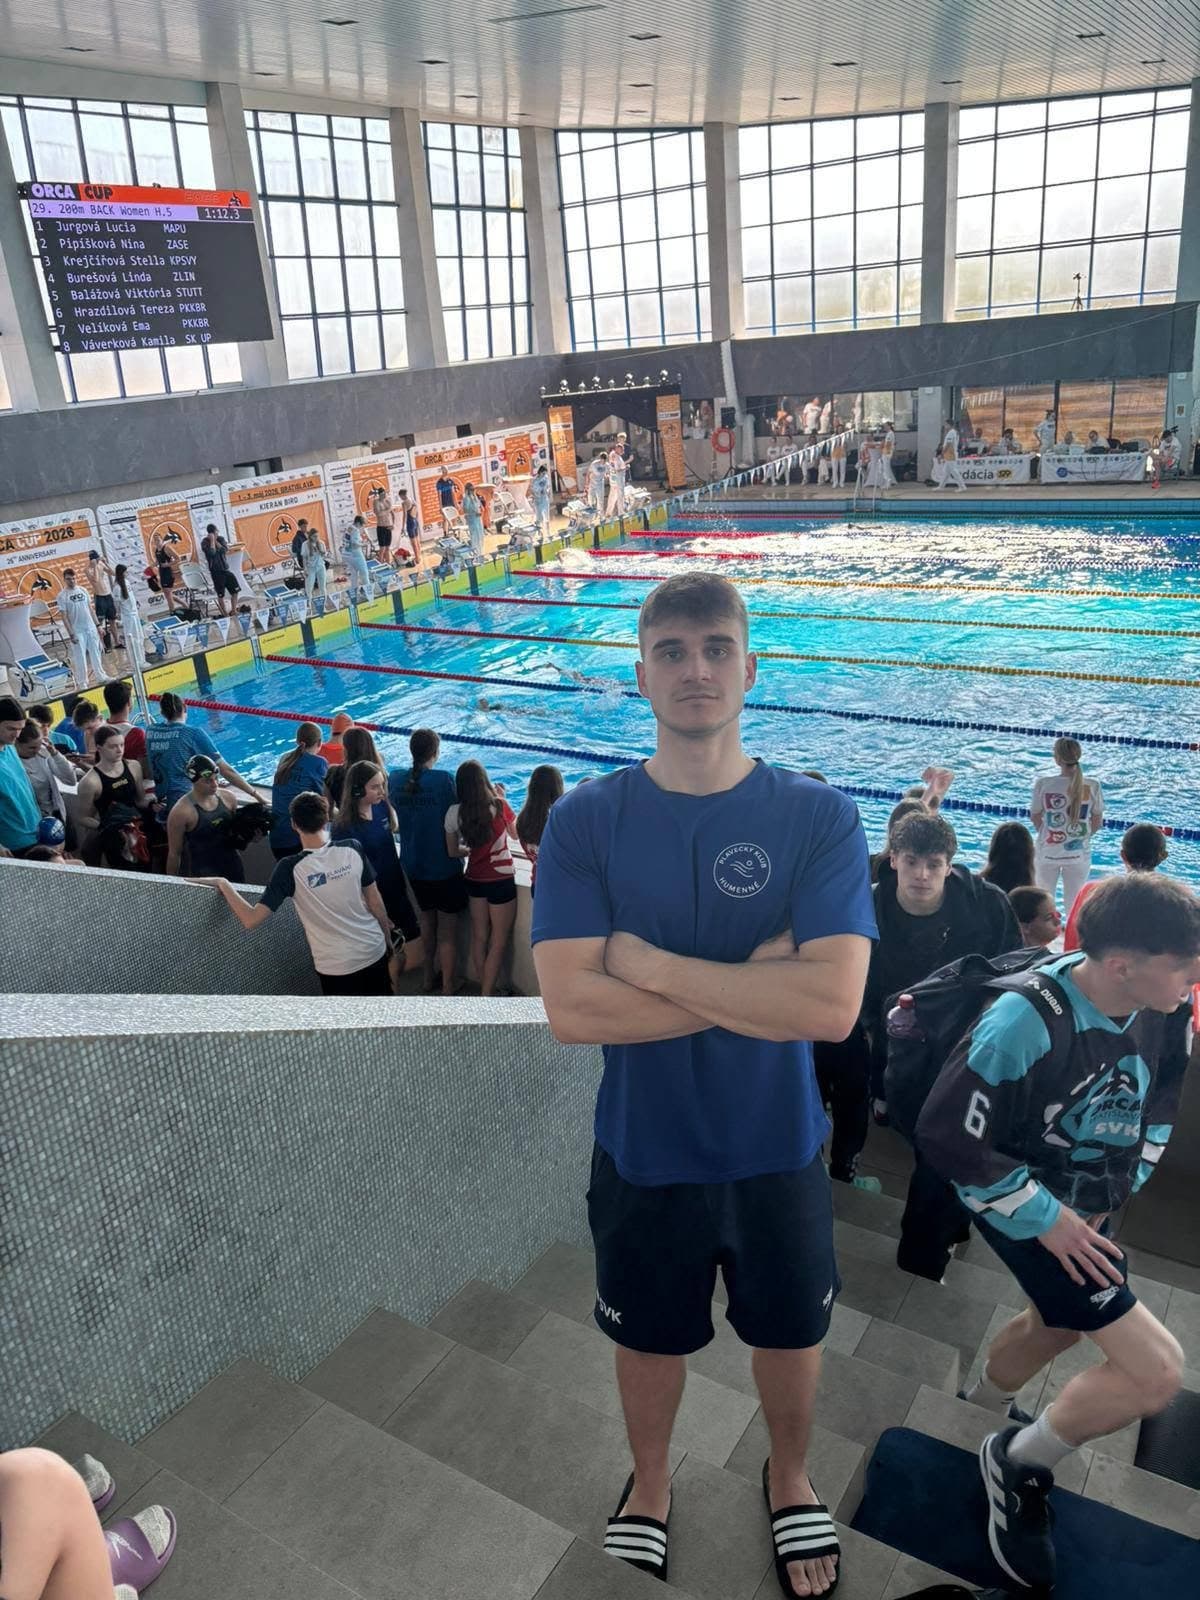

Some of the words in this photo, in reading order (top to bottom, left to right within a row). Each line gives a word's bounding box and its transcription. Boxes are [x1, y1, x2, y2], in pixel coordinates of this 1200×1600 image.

[31, 183, 76, 199] ORCA
[84, 185, 113, 200] CUP
[32, 203, 51, 214] 29.
[59, 203, 85, 214] 200m
[90, 204, 116, 215] BACK
[120, 205, 150, 217] Women
[154, 207, 173, 218] H.5
[204, 208, 241, 220] 1:12.3
[36, 221, 44, 231] 1
[55, 221, 101, 235] Jurgová
[106, 221, 136, 233] Lucia
[163, 223, 187, 234] MAPU
[40, 239, 48, 249] 2
[121, 239, 145, 249] Nina
[166, 239, 190, 250] ZASE
[43, 256, 51, 267] 3
[130, 255, 166, 266] Stella
[48, 273, 55, 283] 4
[67, 272, 118, 284] Burešová
[122, 271, 152, 282] Linda
[173, 271, 196, 282] ZLIN
[51, 291, 59, 302] 5
[70, 288, 121, 300] Balážová
[125, 287, 172, 299] Viktória
[176, 287, 203, 298] STUTT
[55, 308, 63, 318] 6
[74, 305, 136, 318] Hrazdilová
[140, 304, 175, 315] Tereza
[179, 302, 207, 313] PKKBR
[59, 325, 66, 335] 7
[132, 321, 151, 332] Ema
[182, 318, 210, 329] PKKBR
[63, 341, 71, 352] 8
[81, 337, 137, 351] Váverková
[141, 335, 176, 347] Kamila
[185, 334, 197, 345] SK
[200, 333, 212, 343] UP
[950, 469, 994, 480] dácia
[260, 500, 283, 511] KIERAN
[16, 533, 41, 548] CUP
[44, 526, 75, 542] 2026
[754, 851, 767, 869] KLUB
[1040, 988, 1063, 1015] arena
[964, 1090, 993, 1139] 6
